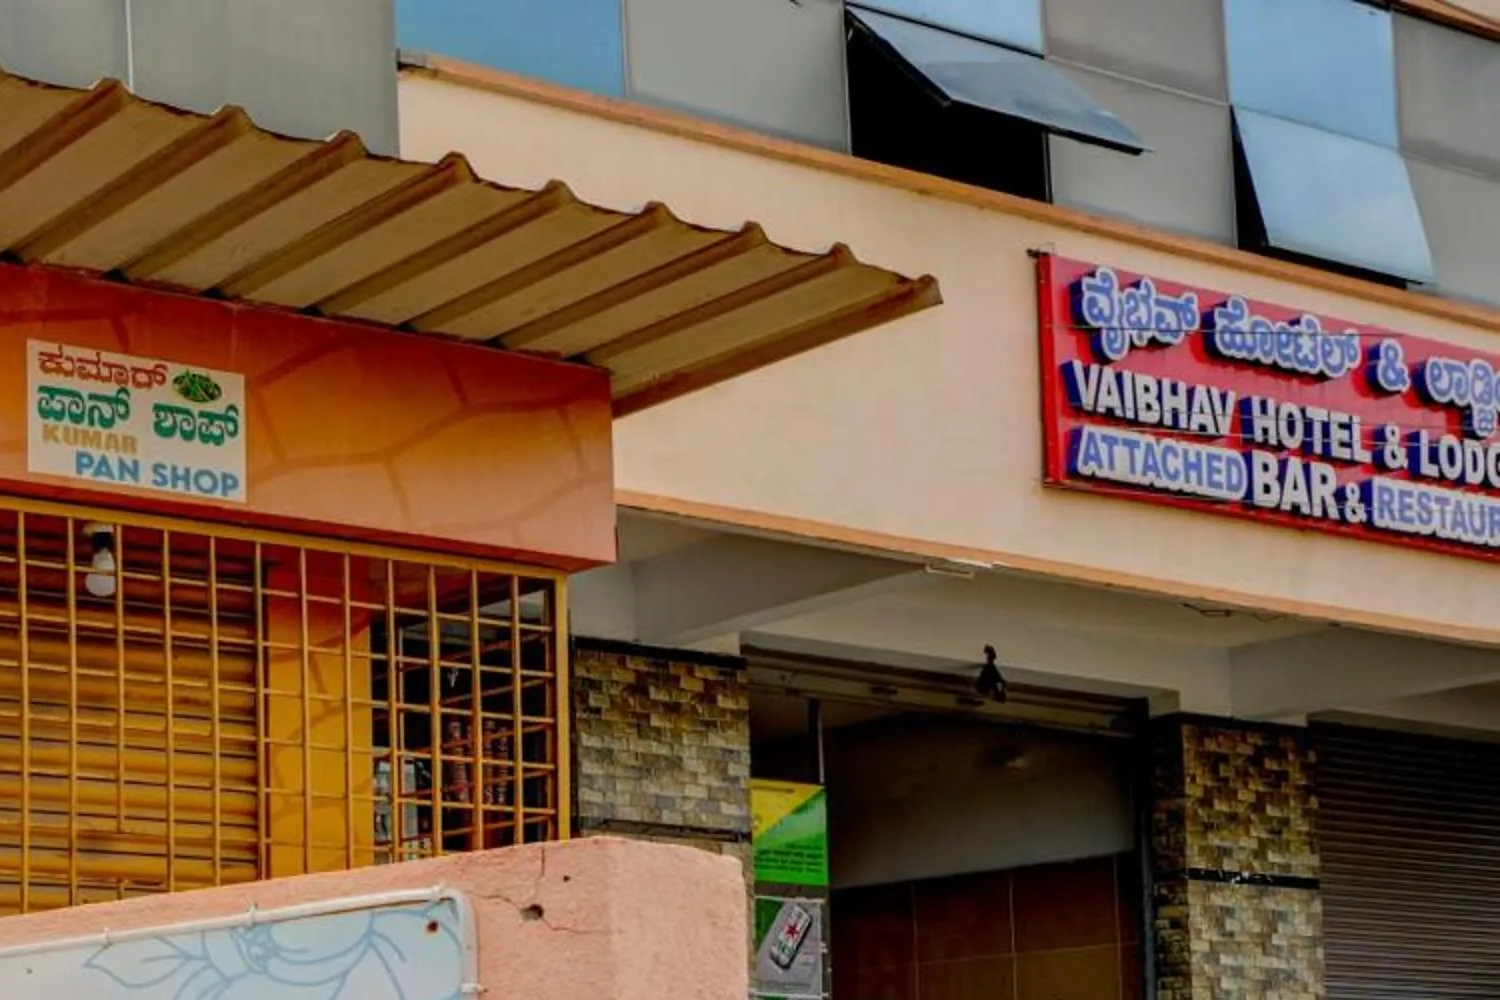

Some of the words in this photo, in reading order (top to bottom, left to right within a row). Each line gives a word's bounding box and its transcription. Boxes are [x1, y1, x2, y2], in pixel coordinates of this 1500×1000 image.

[1378, 339, 1411, 393] &
[41, 424, 138, 456] KUMAR
[1073, 360, 1237, 437] VAIBHAV
[1250, 396, 1372, 465] HOTEL
[1384, 424, 1409, 470] &
[75, 451, 140, 483] PAN
[152, 463, 239, 497] SHOP
[1078, 427, 1248, 498] ATTACHED
[1252, 451, 1339, 521] BAR
[1345, 482, 1368, 523] &
